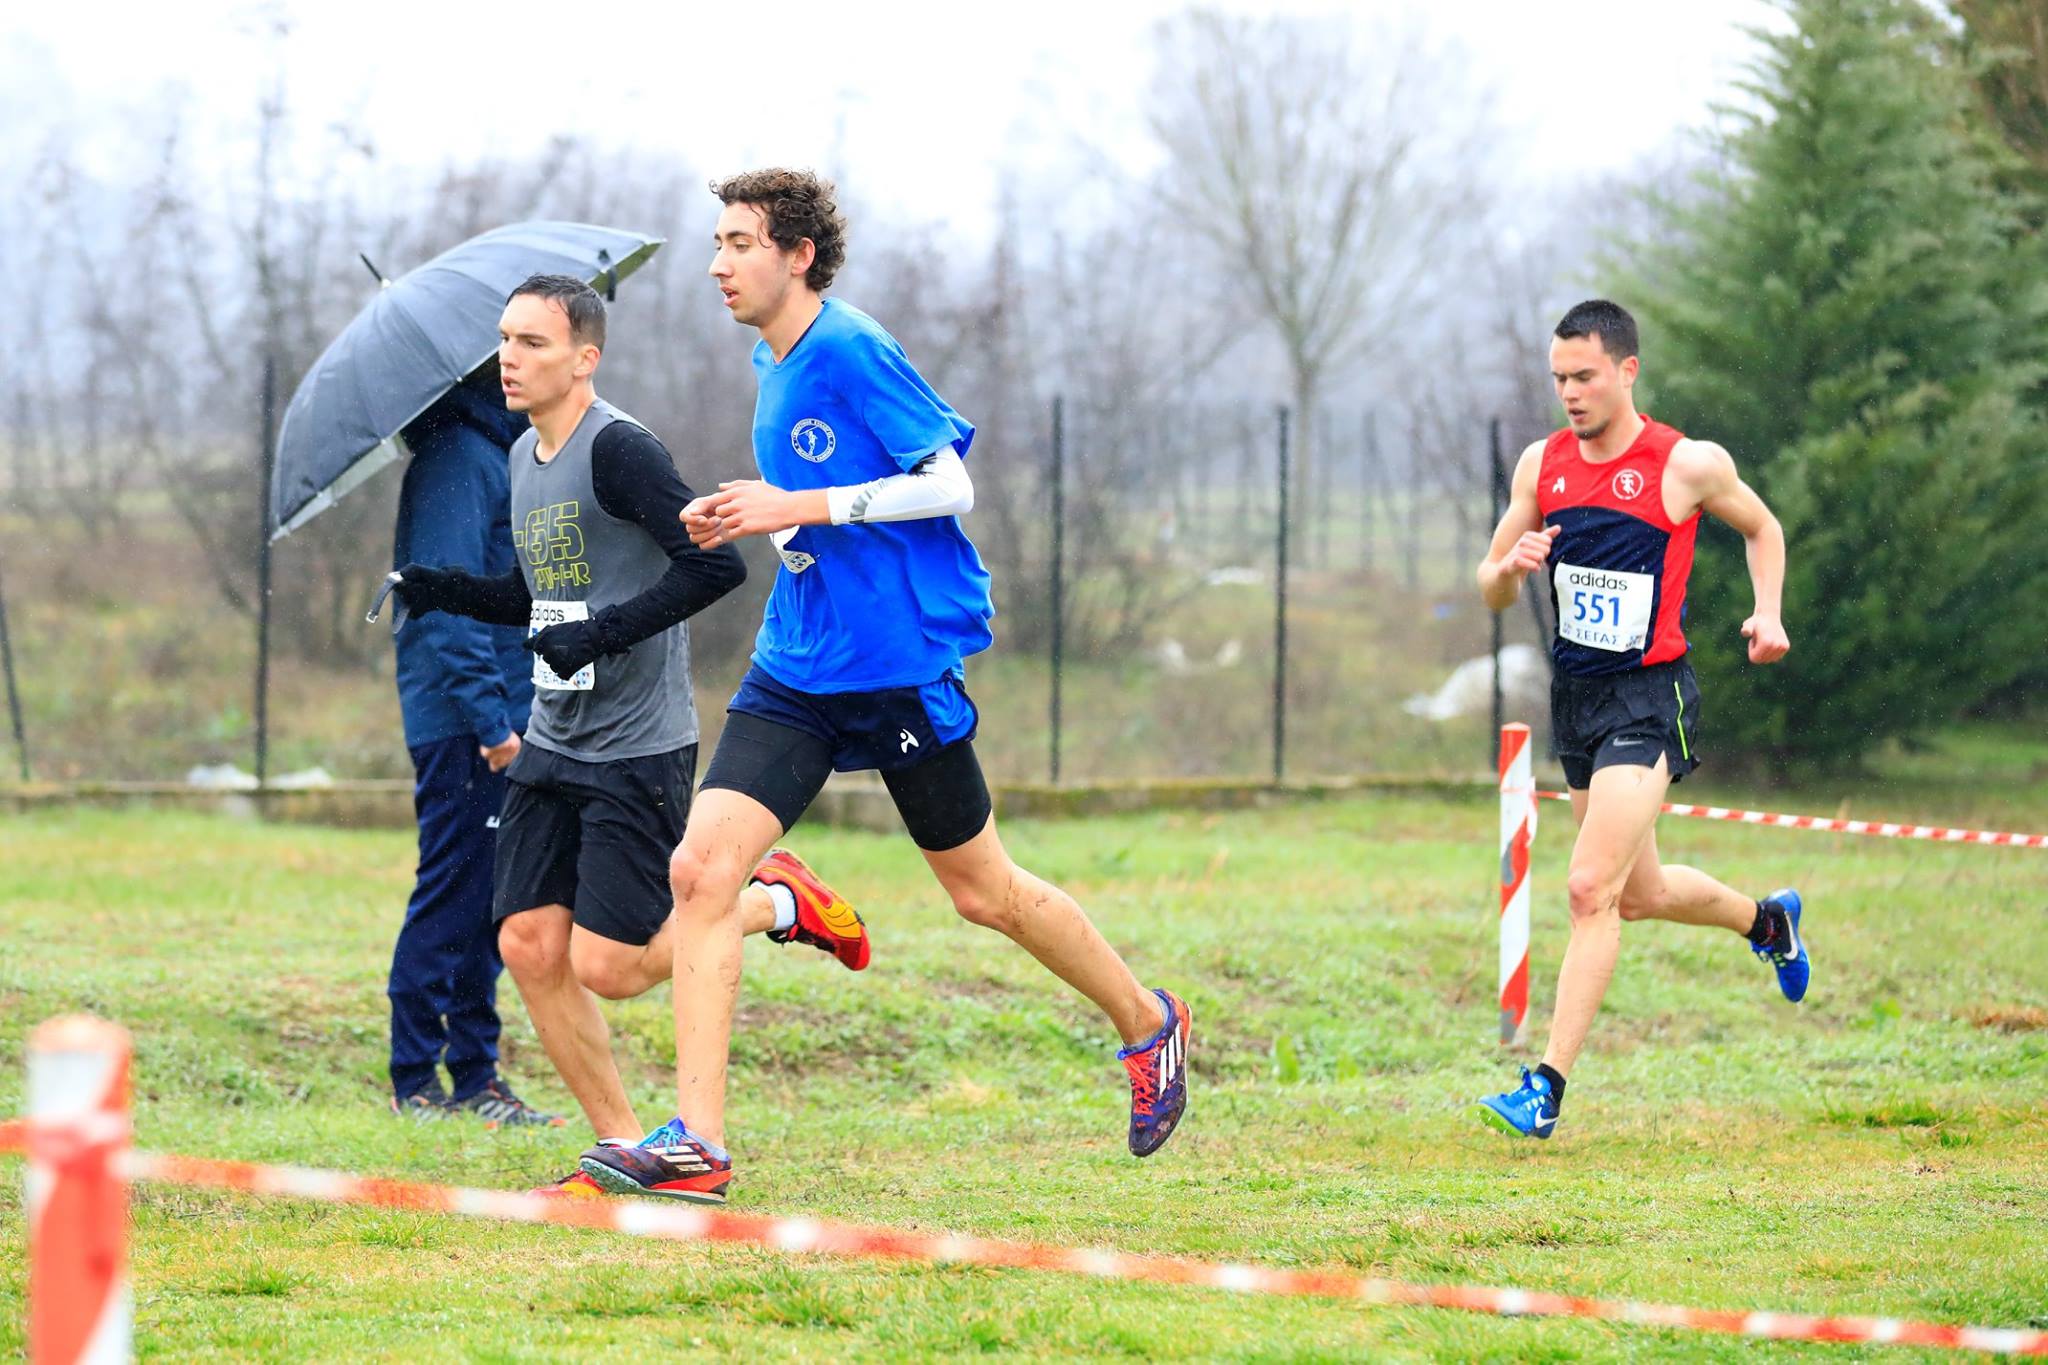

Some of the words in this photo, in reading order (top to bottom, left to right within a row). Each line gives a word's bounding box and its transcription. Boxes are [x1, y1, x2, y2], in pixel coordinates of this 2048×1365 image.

[1569, 572, 1628, 591] adidas
[1574, 591, 1620, 627] 551
[1576, 628, 1620, 645] ΣΕΓΑΣ
